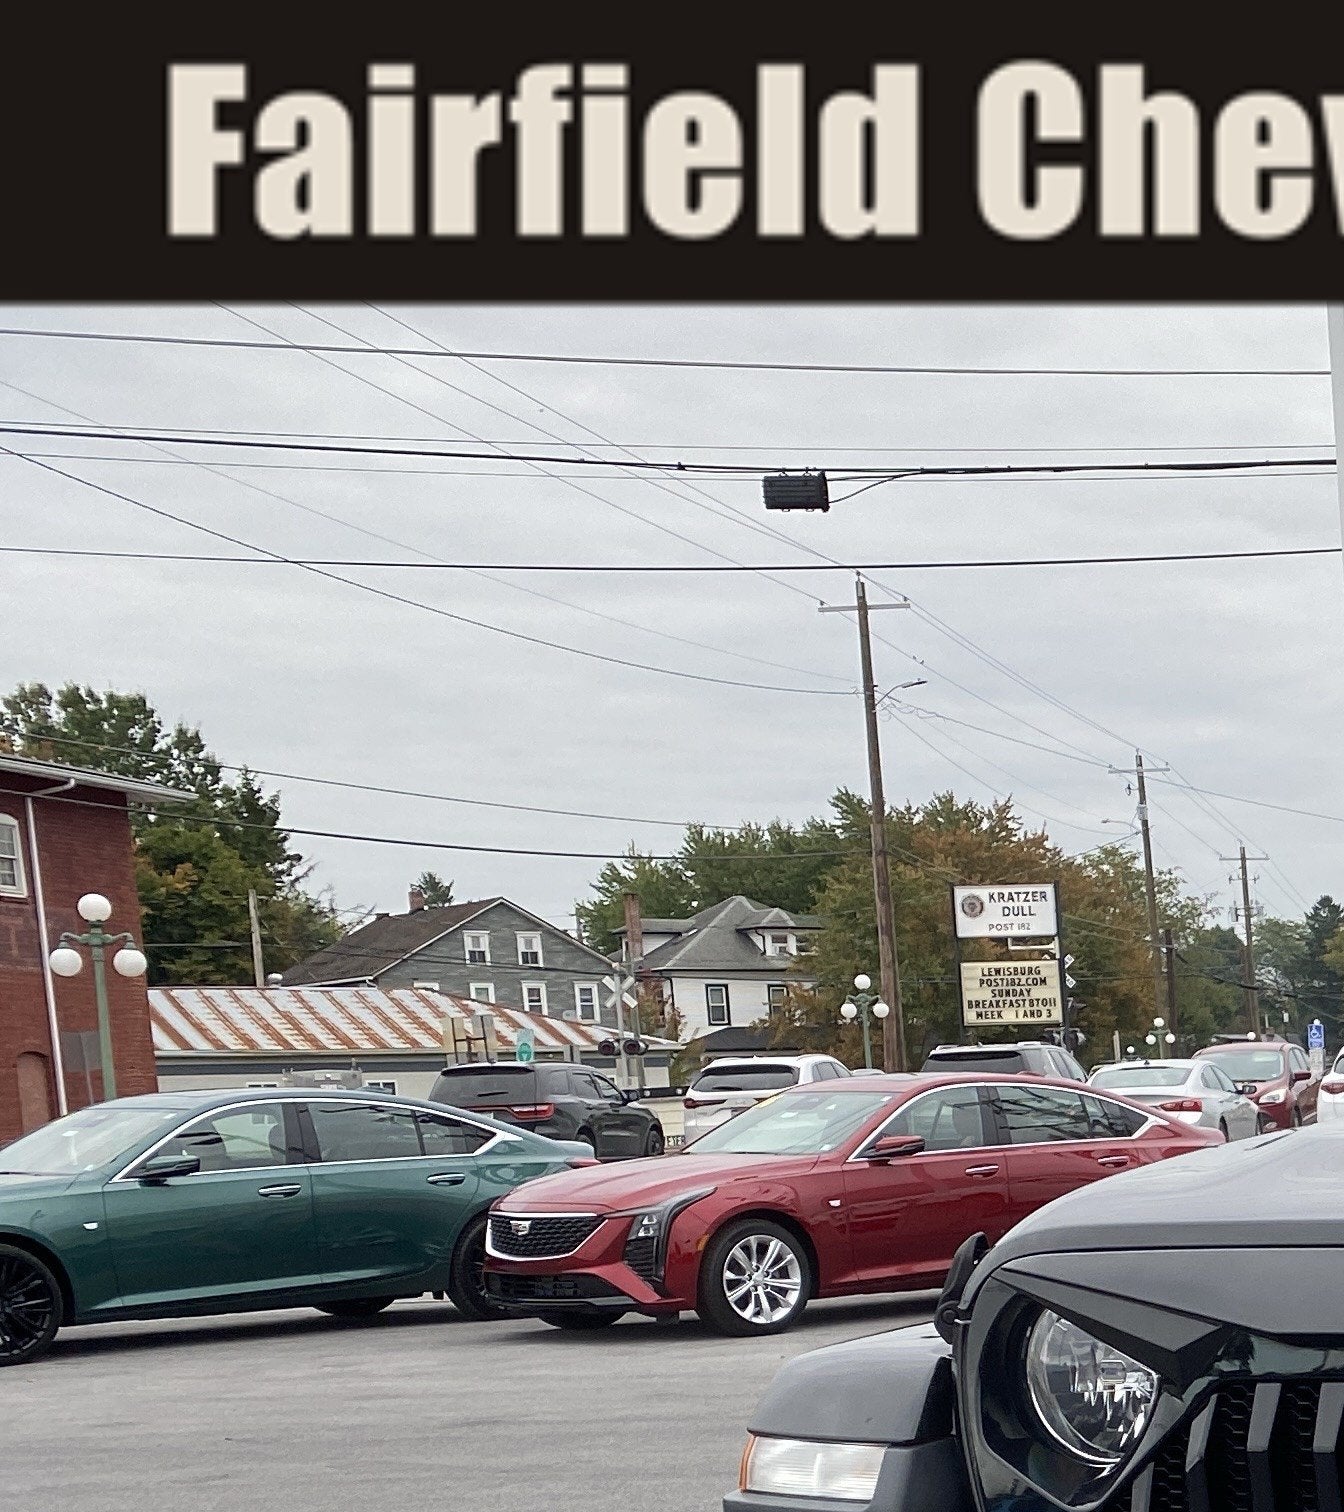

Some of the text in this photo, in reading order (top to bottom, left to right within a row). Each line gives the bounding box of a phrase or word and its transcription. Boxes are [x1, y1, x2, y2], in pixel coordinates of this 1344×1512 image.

[988, 891, 1048, 903] KRATZER
[1002, 905, 1036, 917] DULL
[988, 922, 1031, 932] POST 182
[981, 966, 1041, 977] LEWISBURG
[991, 988, 1032, 998] SUNDAY
[975, 1009, 1004, 1020] WEEK
[1022, 1009, 1043, 1018] AND
[1046, 1009, 1053, 1018] 3
